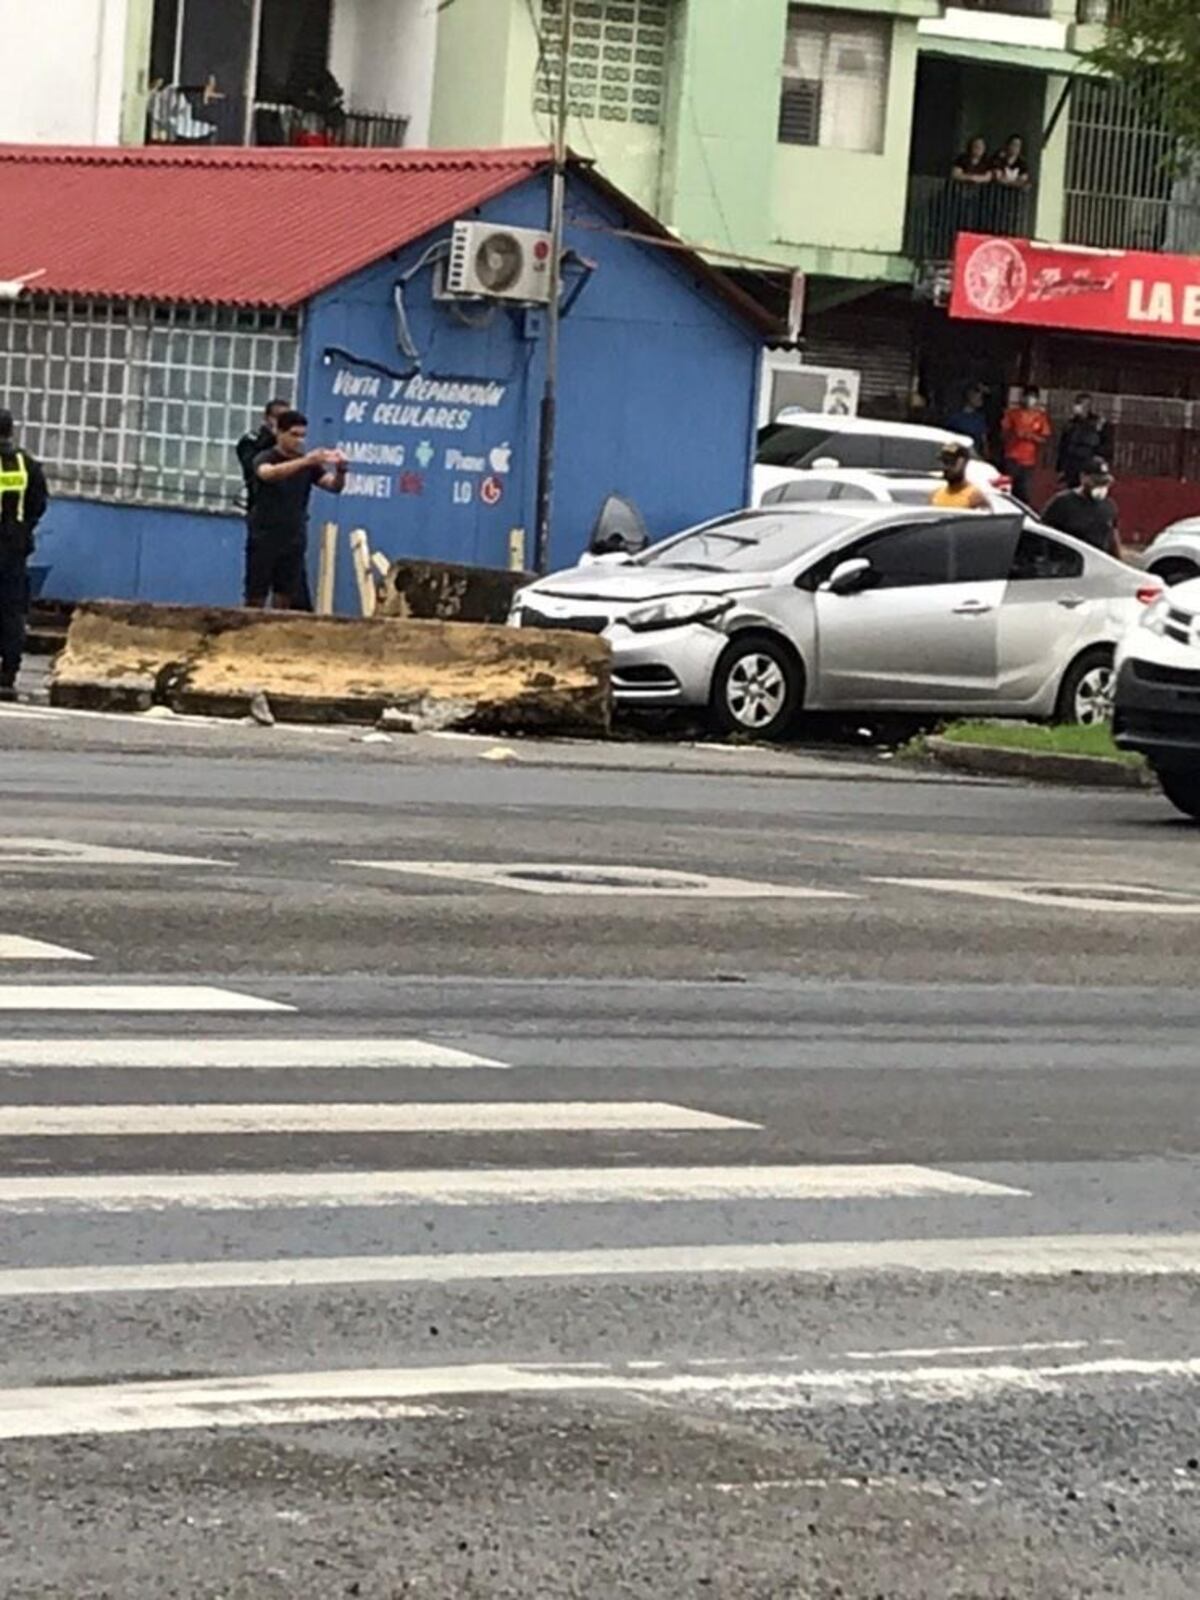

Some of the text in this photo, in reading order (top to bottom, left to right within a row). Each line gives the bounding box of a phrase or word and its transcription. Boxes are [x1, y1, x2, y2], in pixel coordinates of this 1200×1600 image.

[1127, 279, 1174, 323] LA
[389, 380, 403, 399] Y
[344, 401, 471, 430] DE CELULARES
[342, 472, 391, 498] UAWEI
